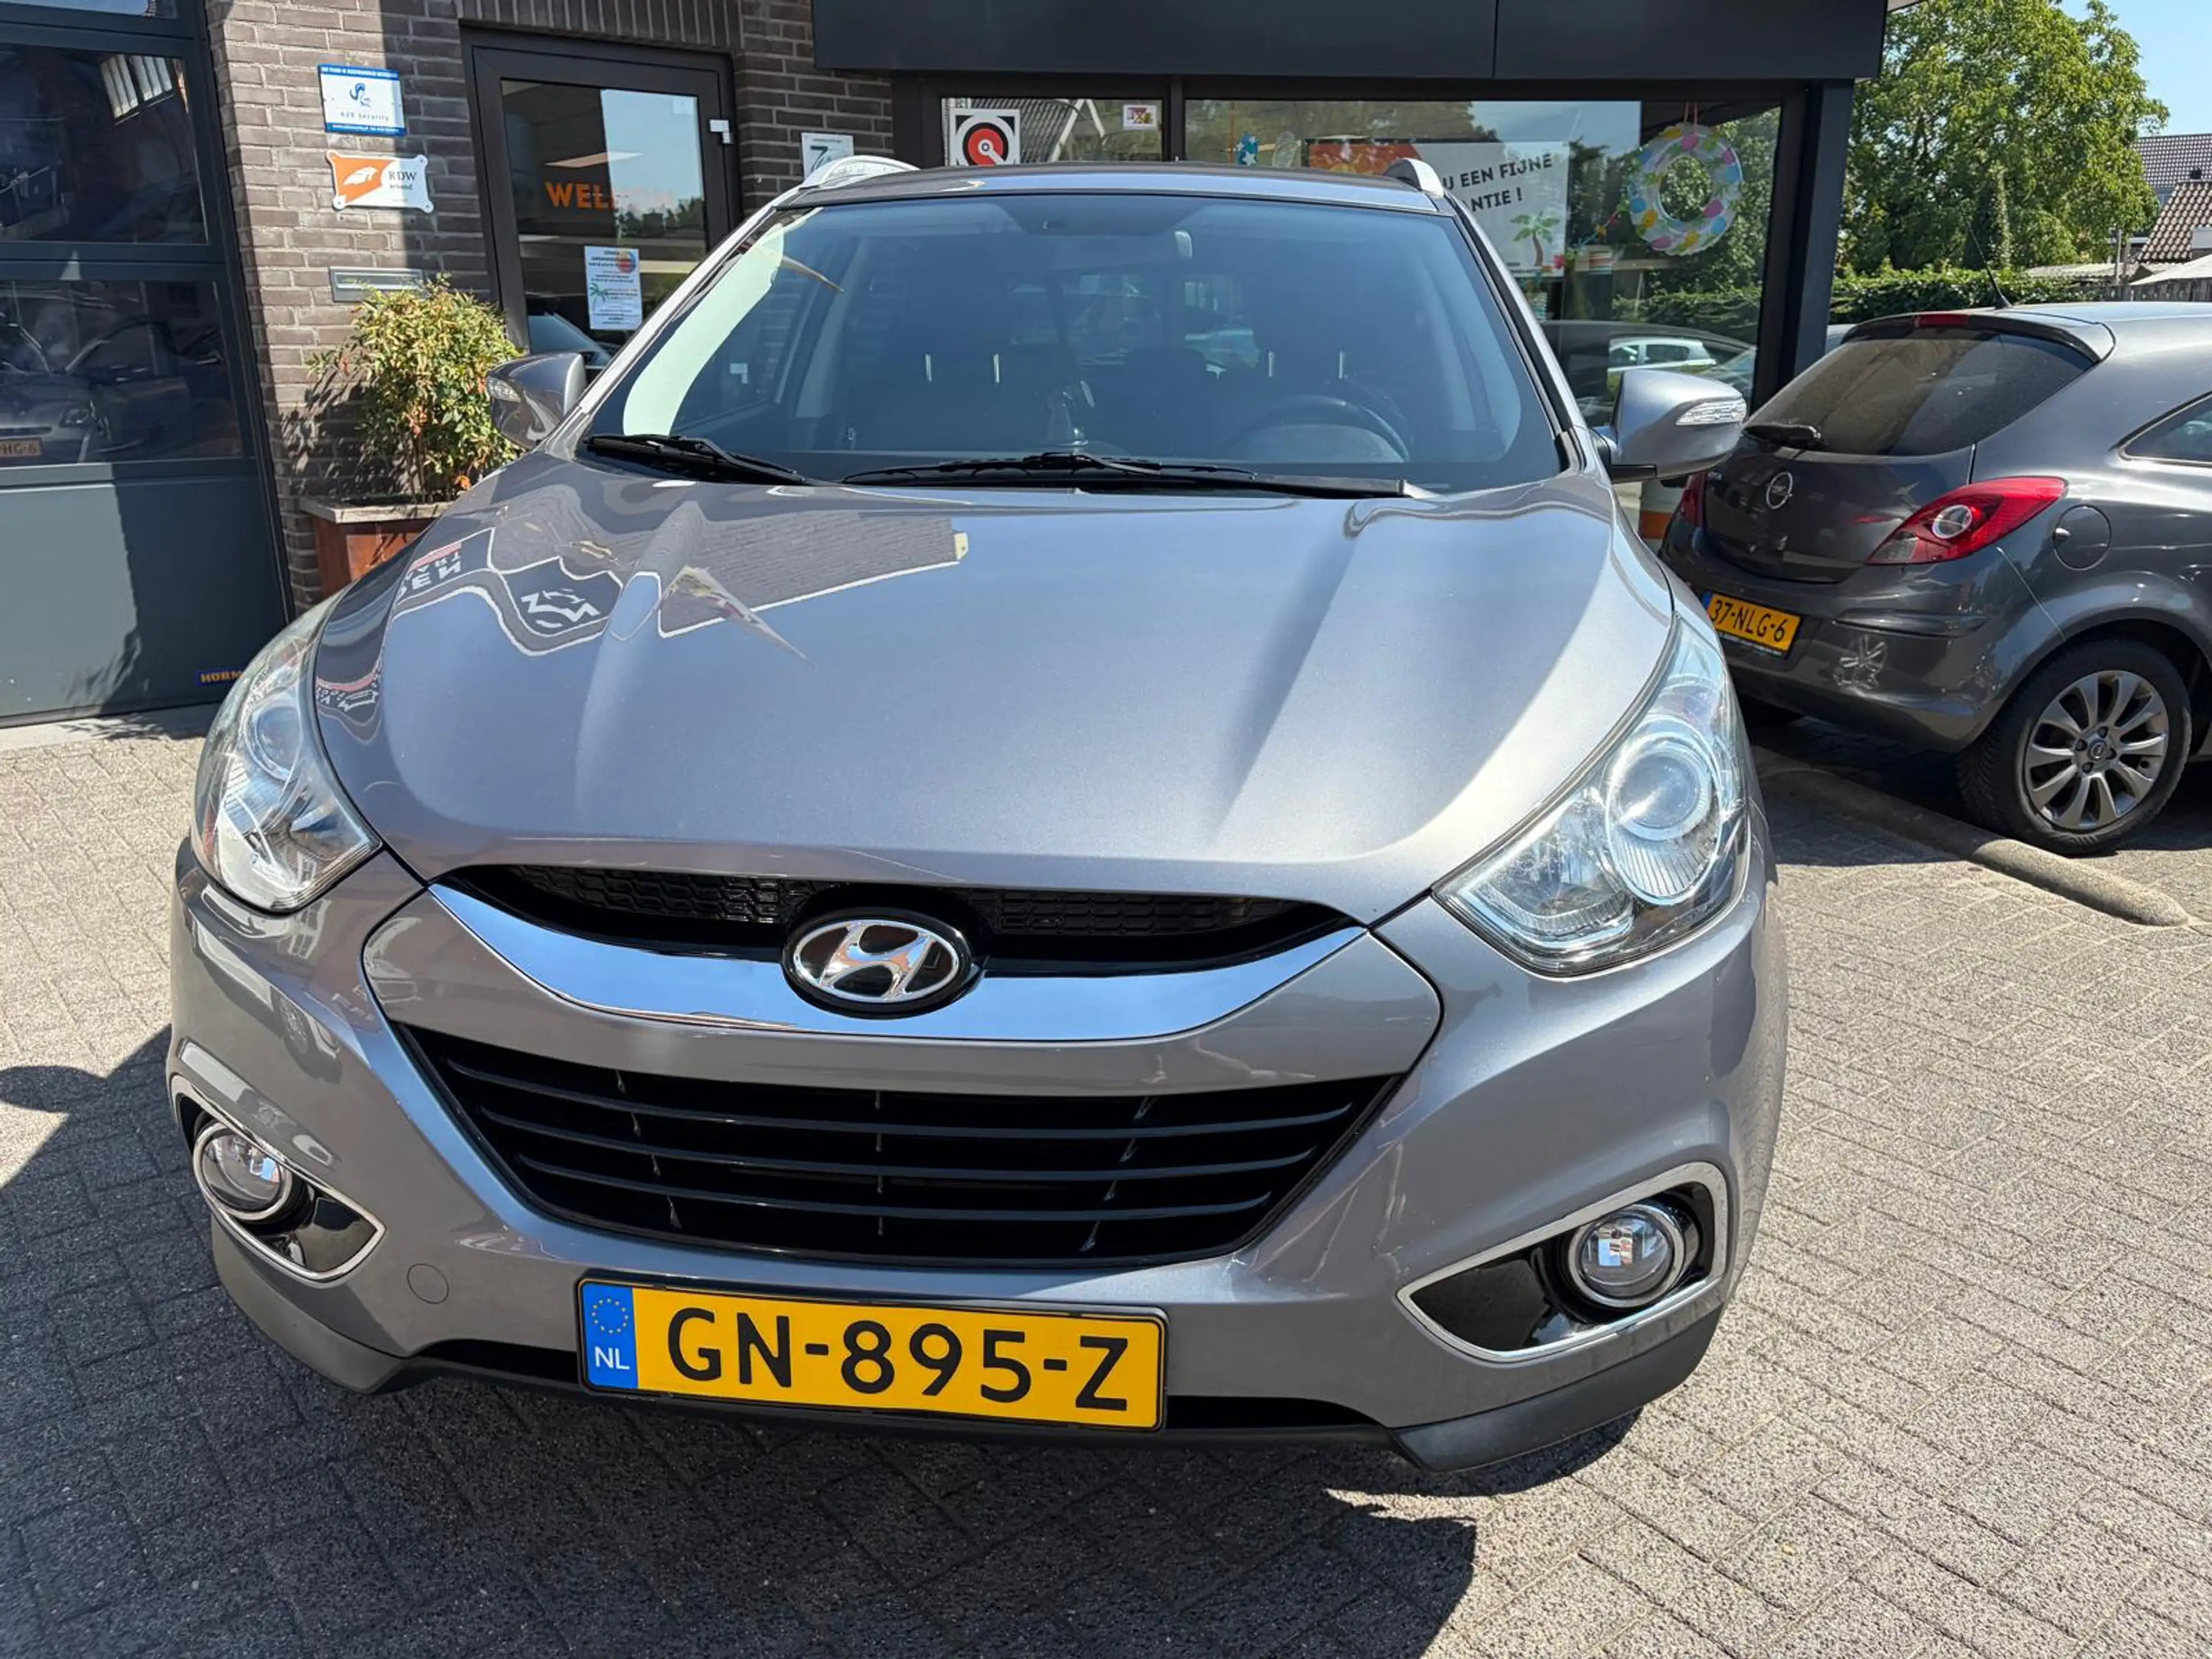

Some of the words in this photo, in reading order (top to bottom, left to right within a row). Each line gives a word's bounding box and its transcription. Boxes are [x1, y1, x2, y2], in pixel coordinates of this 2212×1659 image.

[388, 171, 418, 181] RDW
[1460, 167, 1494, 187] EEN
[1499, 153, 1552, 178] FIJNE
[1710, 599, 1788, 642] 37-NLG-6
[594, 1346, 630, 1371] NL
[667, 1306, 1130, 1412] GN-895-Z
